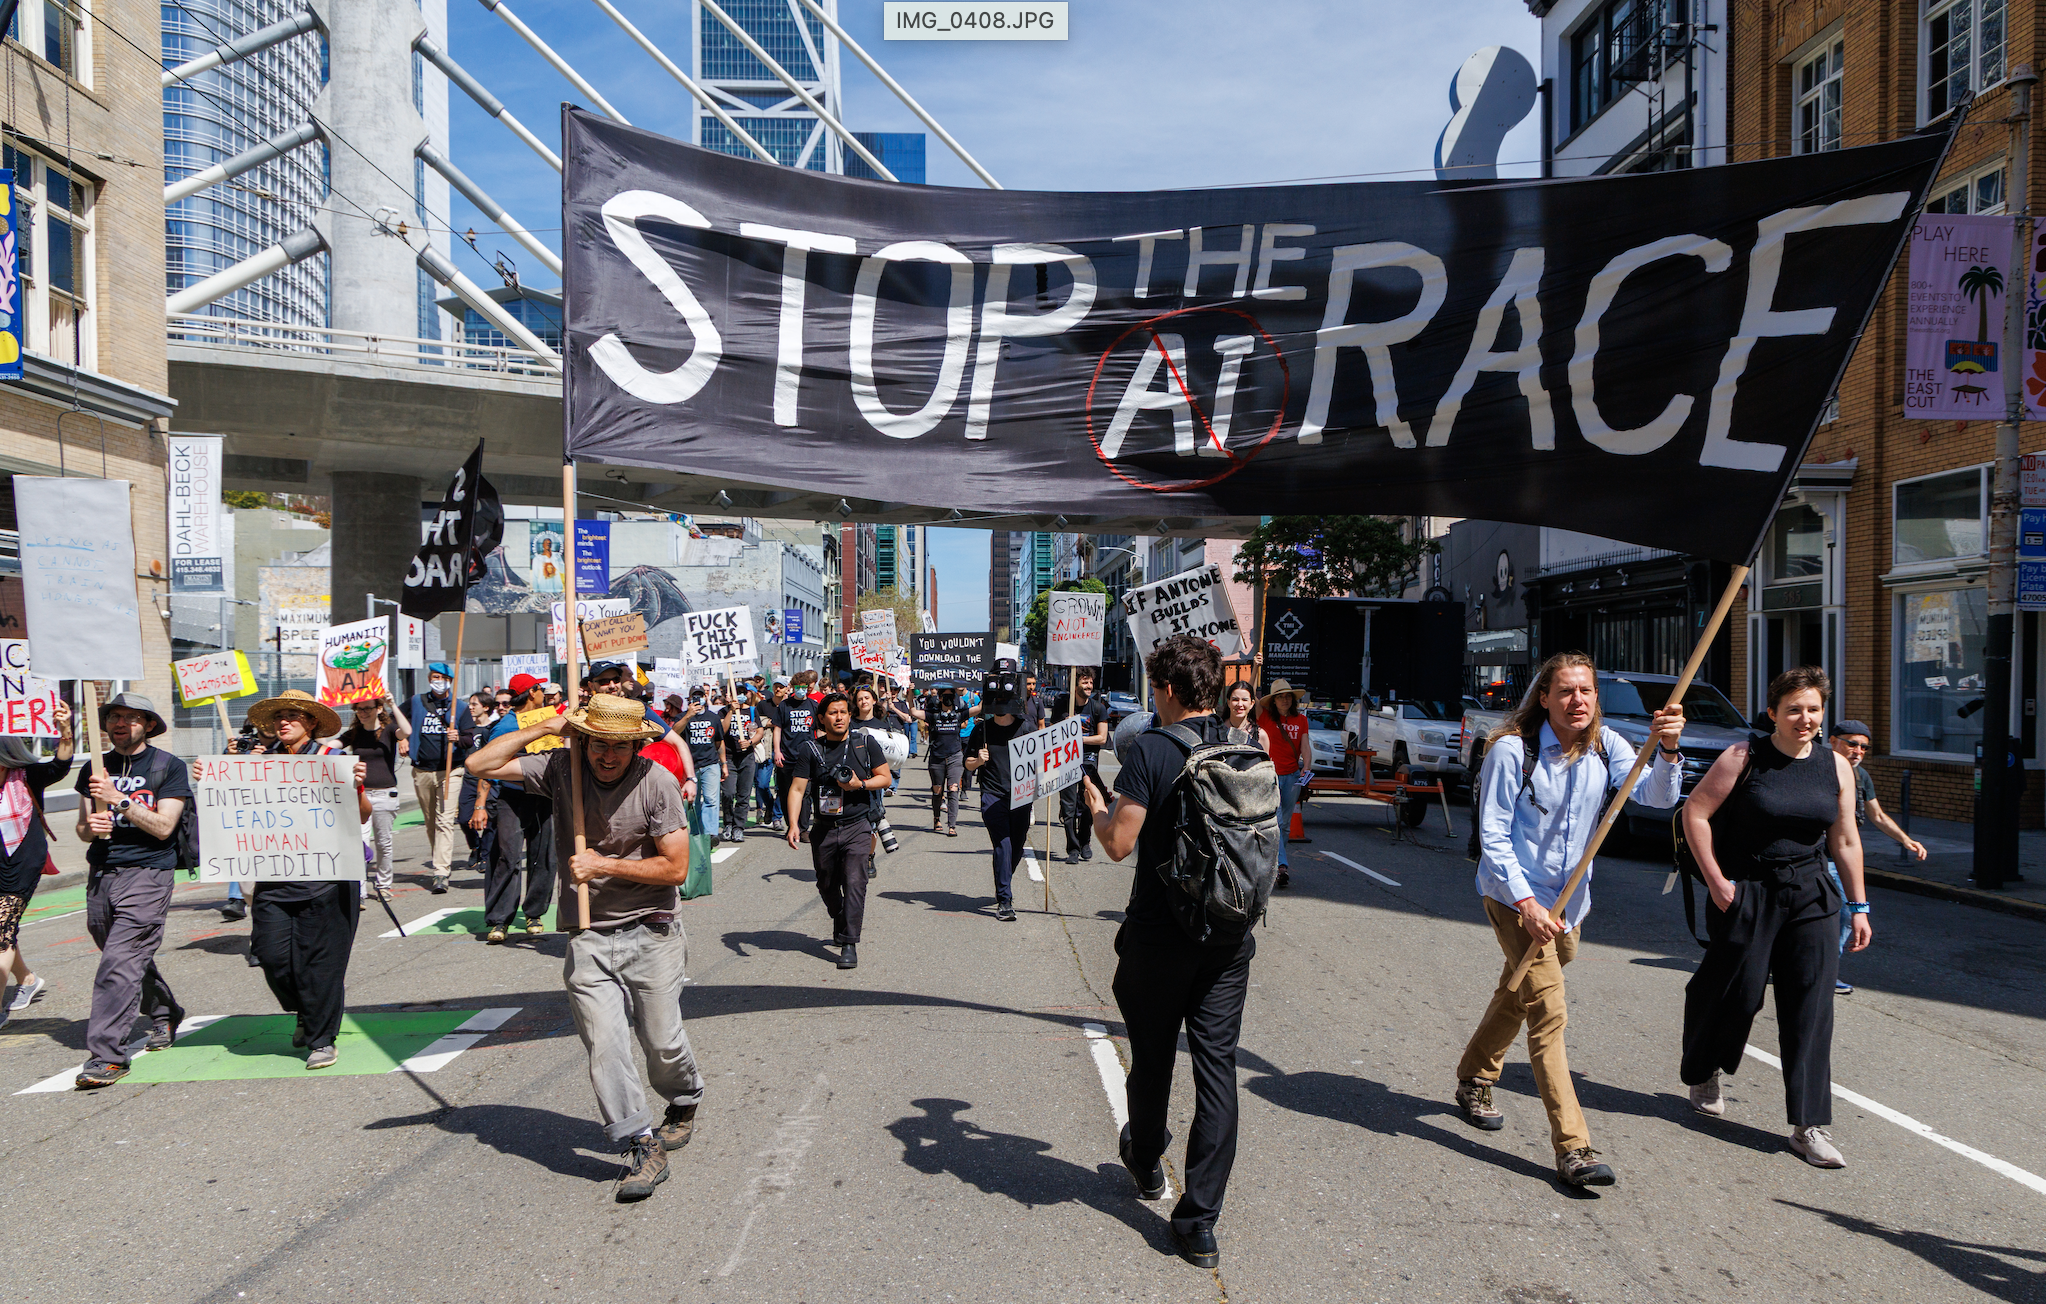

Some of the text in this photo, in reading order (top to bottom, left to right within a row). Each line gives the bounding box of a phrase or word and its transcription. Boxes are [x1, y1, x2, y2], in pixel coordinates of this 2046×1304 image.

[1912, 225, 1954, 241] PLAY
[1944, 246, 1989, 263] HERE
[1911, 281, 1933, 290] 800+
[1911, 293, 1961, 302] EVENTS TO
[1910, 305, 1966, 314] EXPERIENCE
[1909, 317, 1958, 325] ANNUALLY
[587, 190, 1910, 472] STOP THE AI RACE
[1908, 369, 1934, 380] THE
[1907, 382, 1943, 395] EAST
[1906, 396, 1936, 408] CUT
[2021, 456, 2035, 470] NO
[175, 445, 191, 555] DAHL-BECK
[193, 445, 209, 555] WAREHOUSE
[2024, 513, 2041, 525] Pay
[38, 556, 104, 568] CANNOT
[2021, 564, 2039, 574] Pay
[44, 574, 105, 590] TRAIN
[2021, 582, 2045, 590] Plate
[1126, 568, 1222, 616] IF ANYONE
[554, 602, 595, 622] COs
[1053, 598, 1104, 621] GROWN
[1151, 593, 1209, 624] BUILDS
[280, 613, 331, 624] MAXIMUM
[609, 617, 625, 626] CALL
[626, 615, 637, 623] UP
[688, 611, 738, 632] FUCK
[1056, 617, 1087, 631] NOT
[1170, 614, 1189, 632] IT
[325, 625, 387, 648] HUMANITY
[594, 627, 615, 638] WHAT
[619, 625, 636, 634] YOU
[692, 627, 736, 645] THIS
[1052, 631, 1101, 642] ENGINEERED
[611, 638, 625, 647] PUT
[627, 634, 647, 644] DOWN
[849, 634, 864, 645] We
[919, 637, 984, 651] YOU WOULDN'T
[697, 639, 747, 664] SHIT
[1268, 643, 1310, 652] TRAFFIC
[526, 654, 539, 664] CALL
[919, 654, 981, 664] DOWNLOAD THE
[178, 660, 211, 678] STOP
[504, 666, 523, 677] THAT
[913, 669, 956, 681] TORMENT
[340, 669, 369, 691] AI
[0, 690, 59, 735] ER!
[790, 710, 811, 718] STOP
[690, 721, 711, 729] STOP
[790, 717, 806, 725] THE
[690, 729, 706, 737] THE
[790, 725, 810, 733] RACE
[1013, 720, 1079, 758] VOTE NO
[1014, 740, 1080, 781] ON FISA
[205, 760, 345, 784] ARTIFICIAL
[109, 776, 146, 792] TOP
[1014, 783, 1025, 796] NO
[205, 787, 342, 807] INTELLIGENCE
[222, 808, 335, 829] LEADS TO
[235, 833, 309, 852] HUMAN
[208, 852, 341, 877] STUPIDITY
